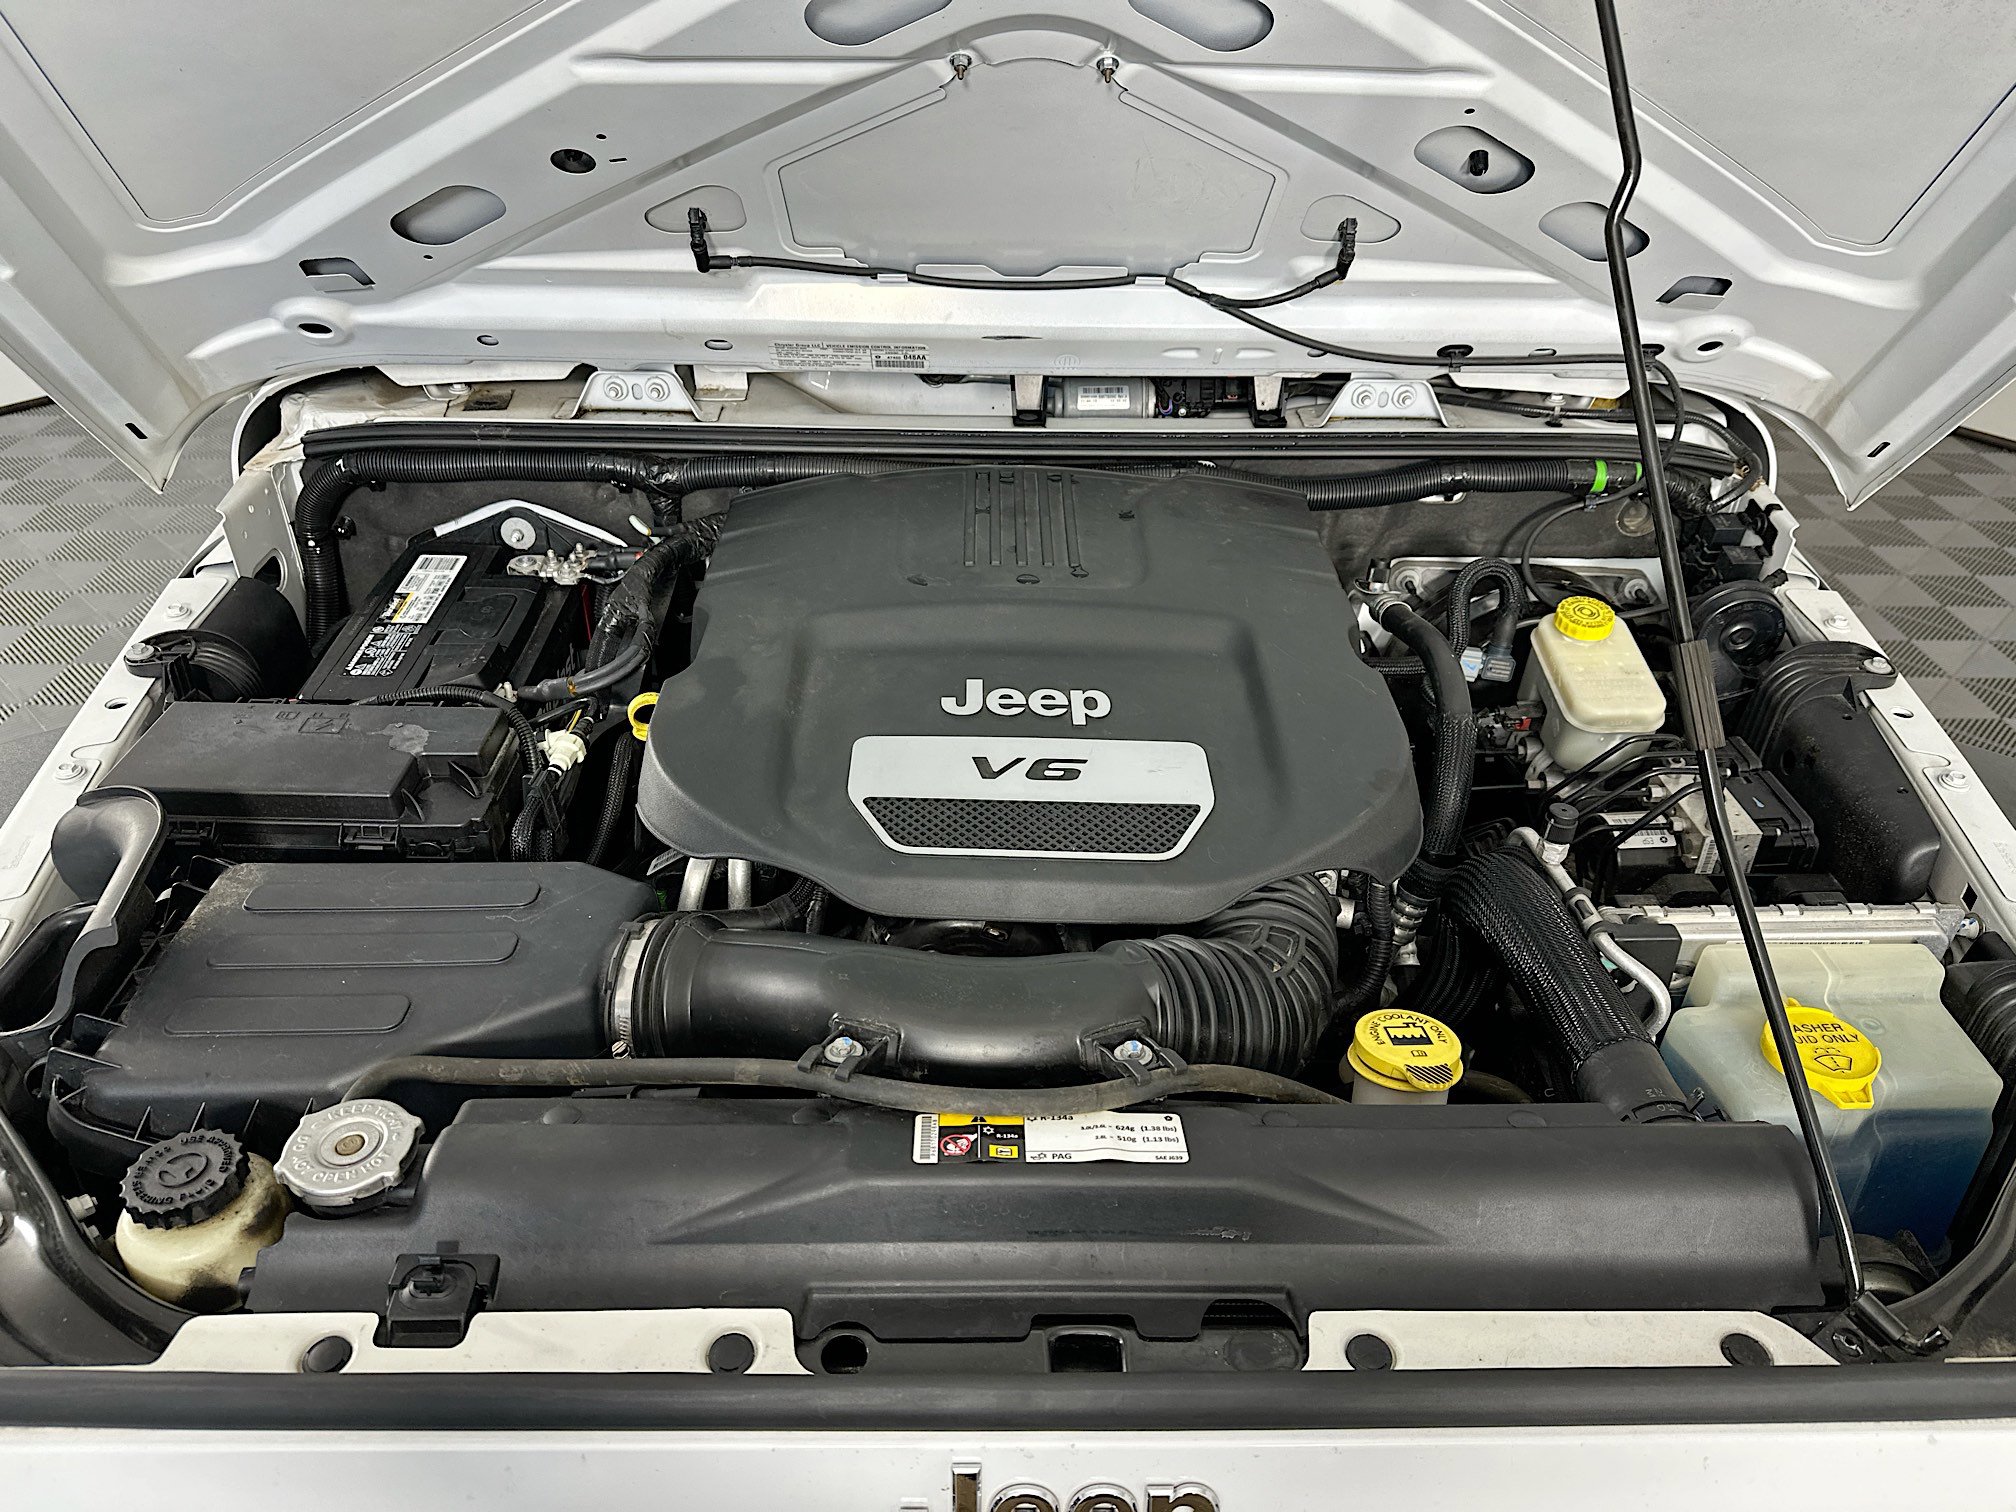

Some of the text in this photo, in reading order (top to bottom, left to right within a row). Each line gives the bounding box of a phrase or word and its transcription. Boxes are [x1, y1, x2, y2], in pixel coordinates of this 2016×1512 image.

[940, 678, 1112, 725] Jeep
[971, 756, 1089, 781] V6
[1369, 1014, 1448, 1045] ENGINE COOLANT ONLY
[1792, 1023, 1844, 1033] ASHER
[1795, 1033, 1860, 1044] UID ONLY
[327, 1104, 372, 1121] KEEP
[1162, 1125, 1177, 1133] lbs)
[1117, 1135, 1137, 1143] 510g
[312, 1170, 358, 1182] OPEN
[360, 1152, 390, 1174] HOT
